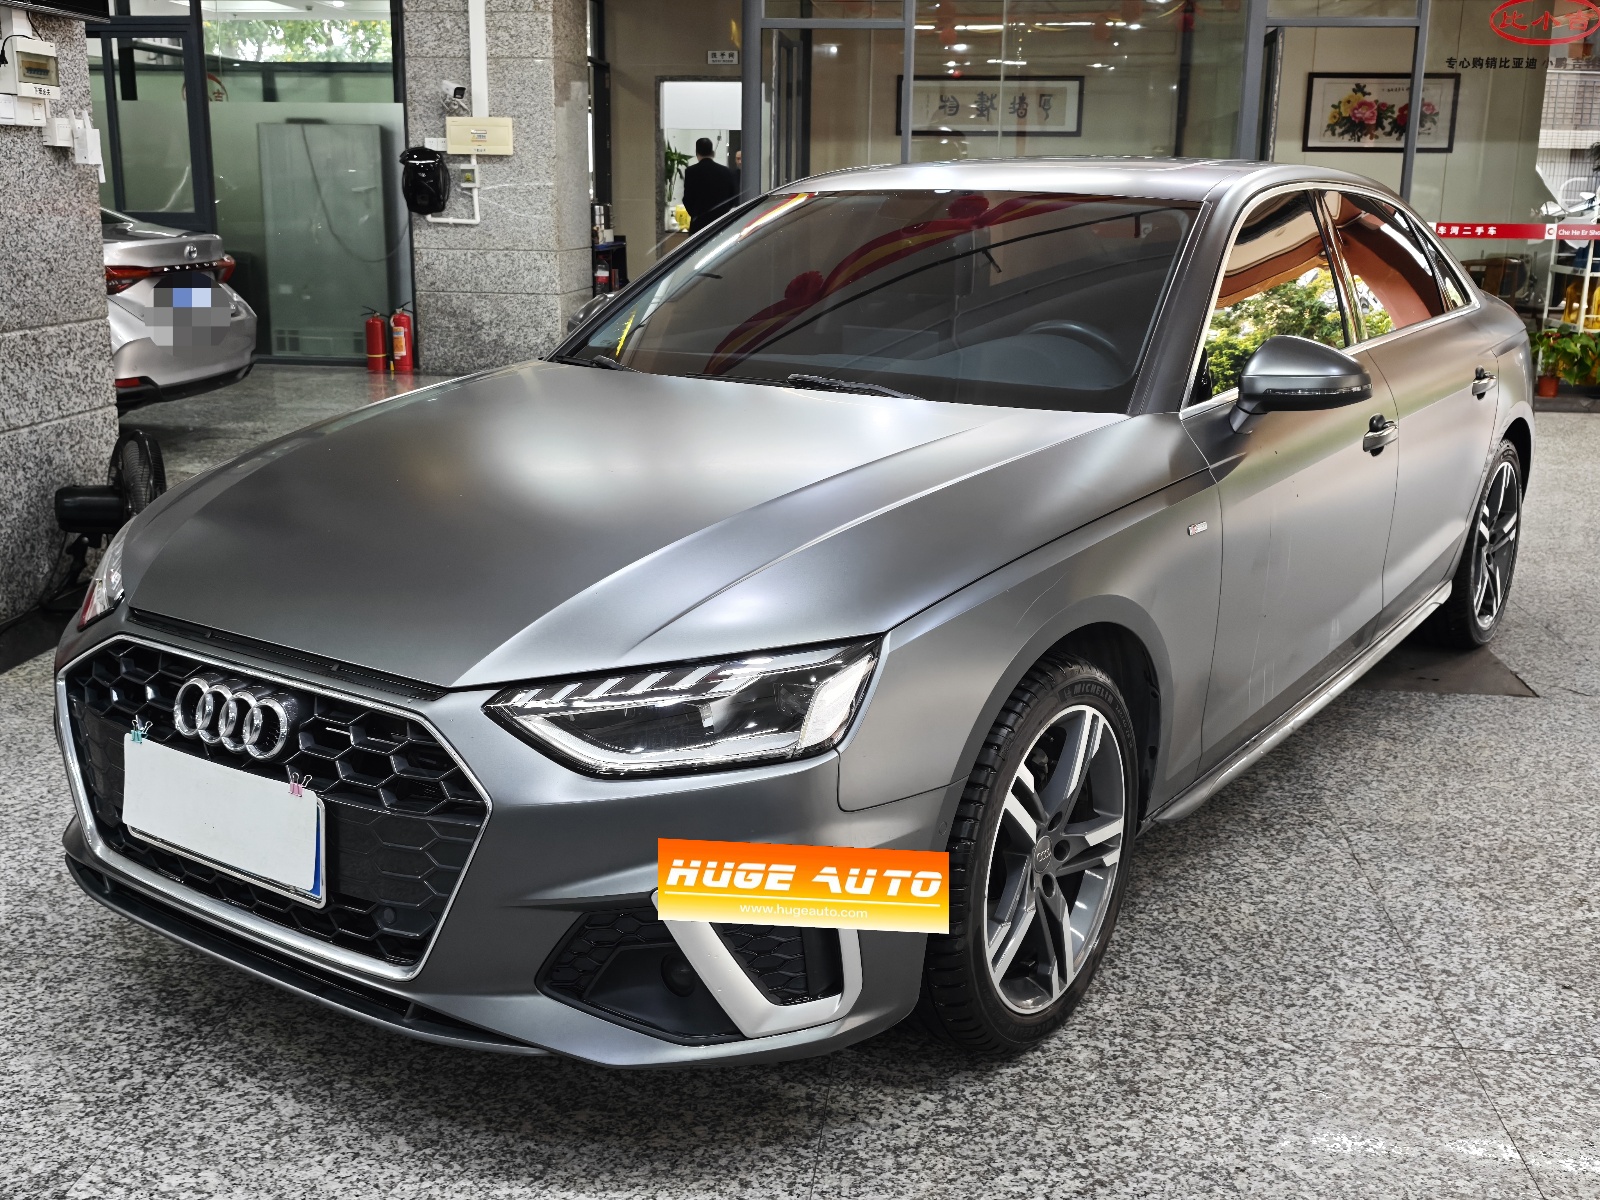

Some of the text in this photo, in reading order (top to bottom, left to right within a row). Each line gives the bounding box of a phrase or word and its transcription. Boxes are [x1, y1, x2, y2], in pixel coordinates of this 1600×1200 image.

[1499, 9, 1596, 31] 比小吉
[1445, 56, 1538, 70] 专心购销比亚迪
[1437, 226, 1498, 236] 车河二手车
[1073, 683, 1114, 704] MICHELIN
